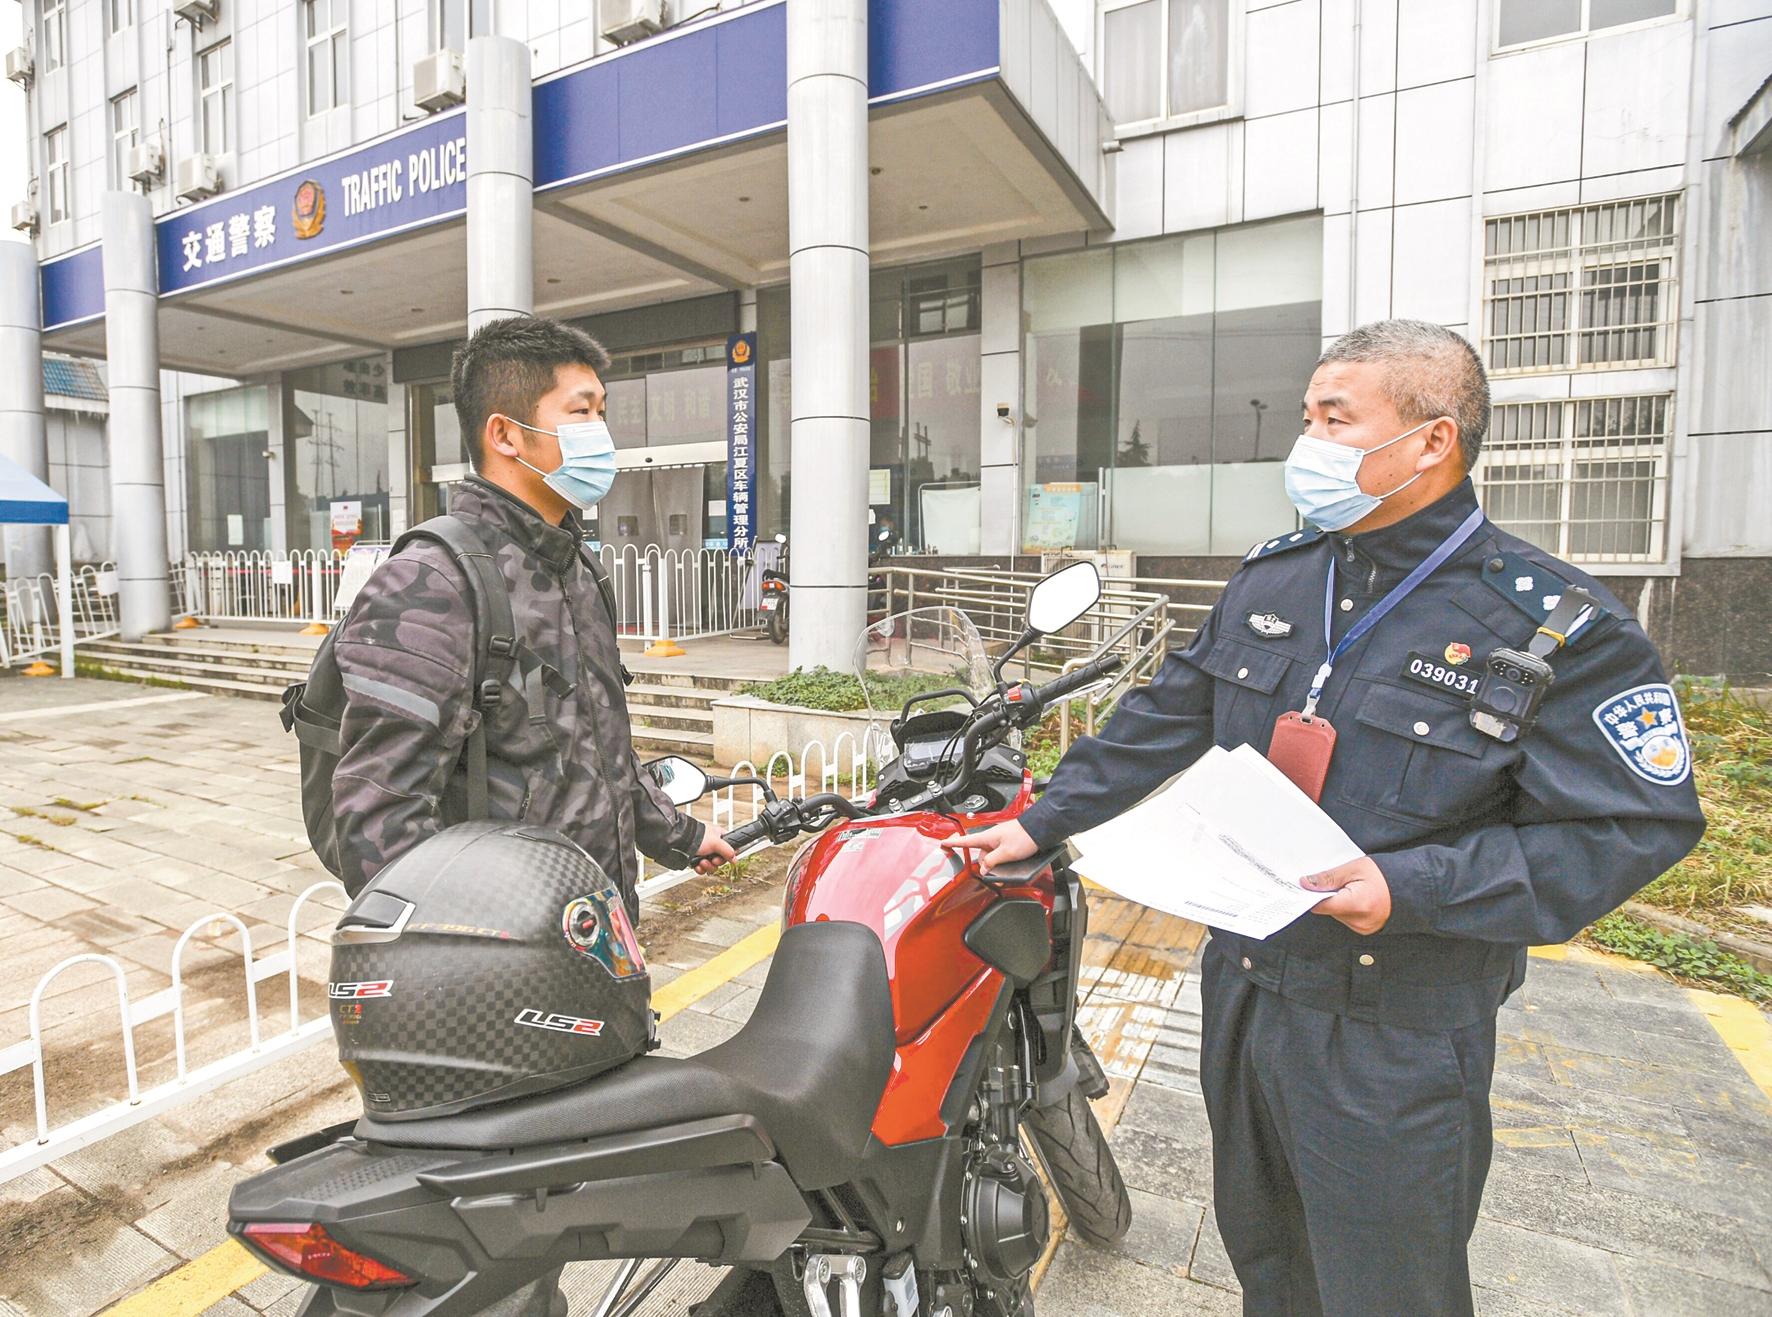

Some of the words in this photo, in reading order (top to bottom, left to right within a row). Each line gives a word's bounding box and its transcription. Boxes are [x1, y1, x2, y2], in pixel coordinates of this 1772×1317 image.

[341, 159, 402, 217] TRAFFIC
[408, 136, 467, 197] POLICE
[181, 204, 277, 273] 交通警察
[732, 376, 750, 549] 武汉市公安局江夏区车辆管理分所
[1409, 658, 1480, 695] 039031
[1603, 691, 1672, 726] 中华人民共和国
[328, 979, 394, 999] LS2
[514, 1008, 605, 1037] LS2
